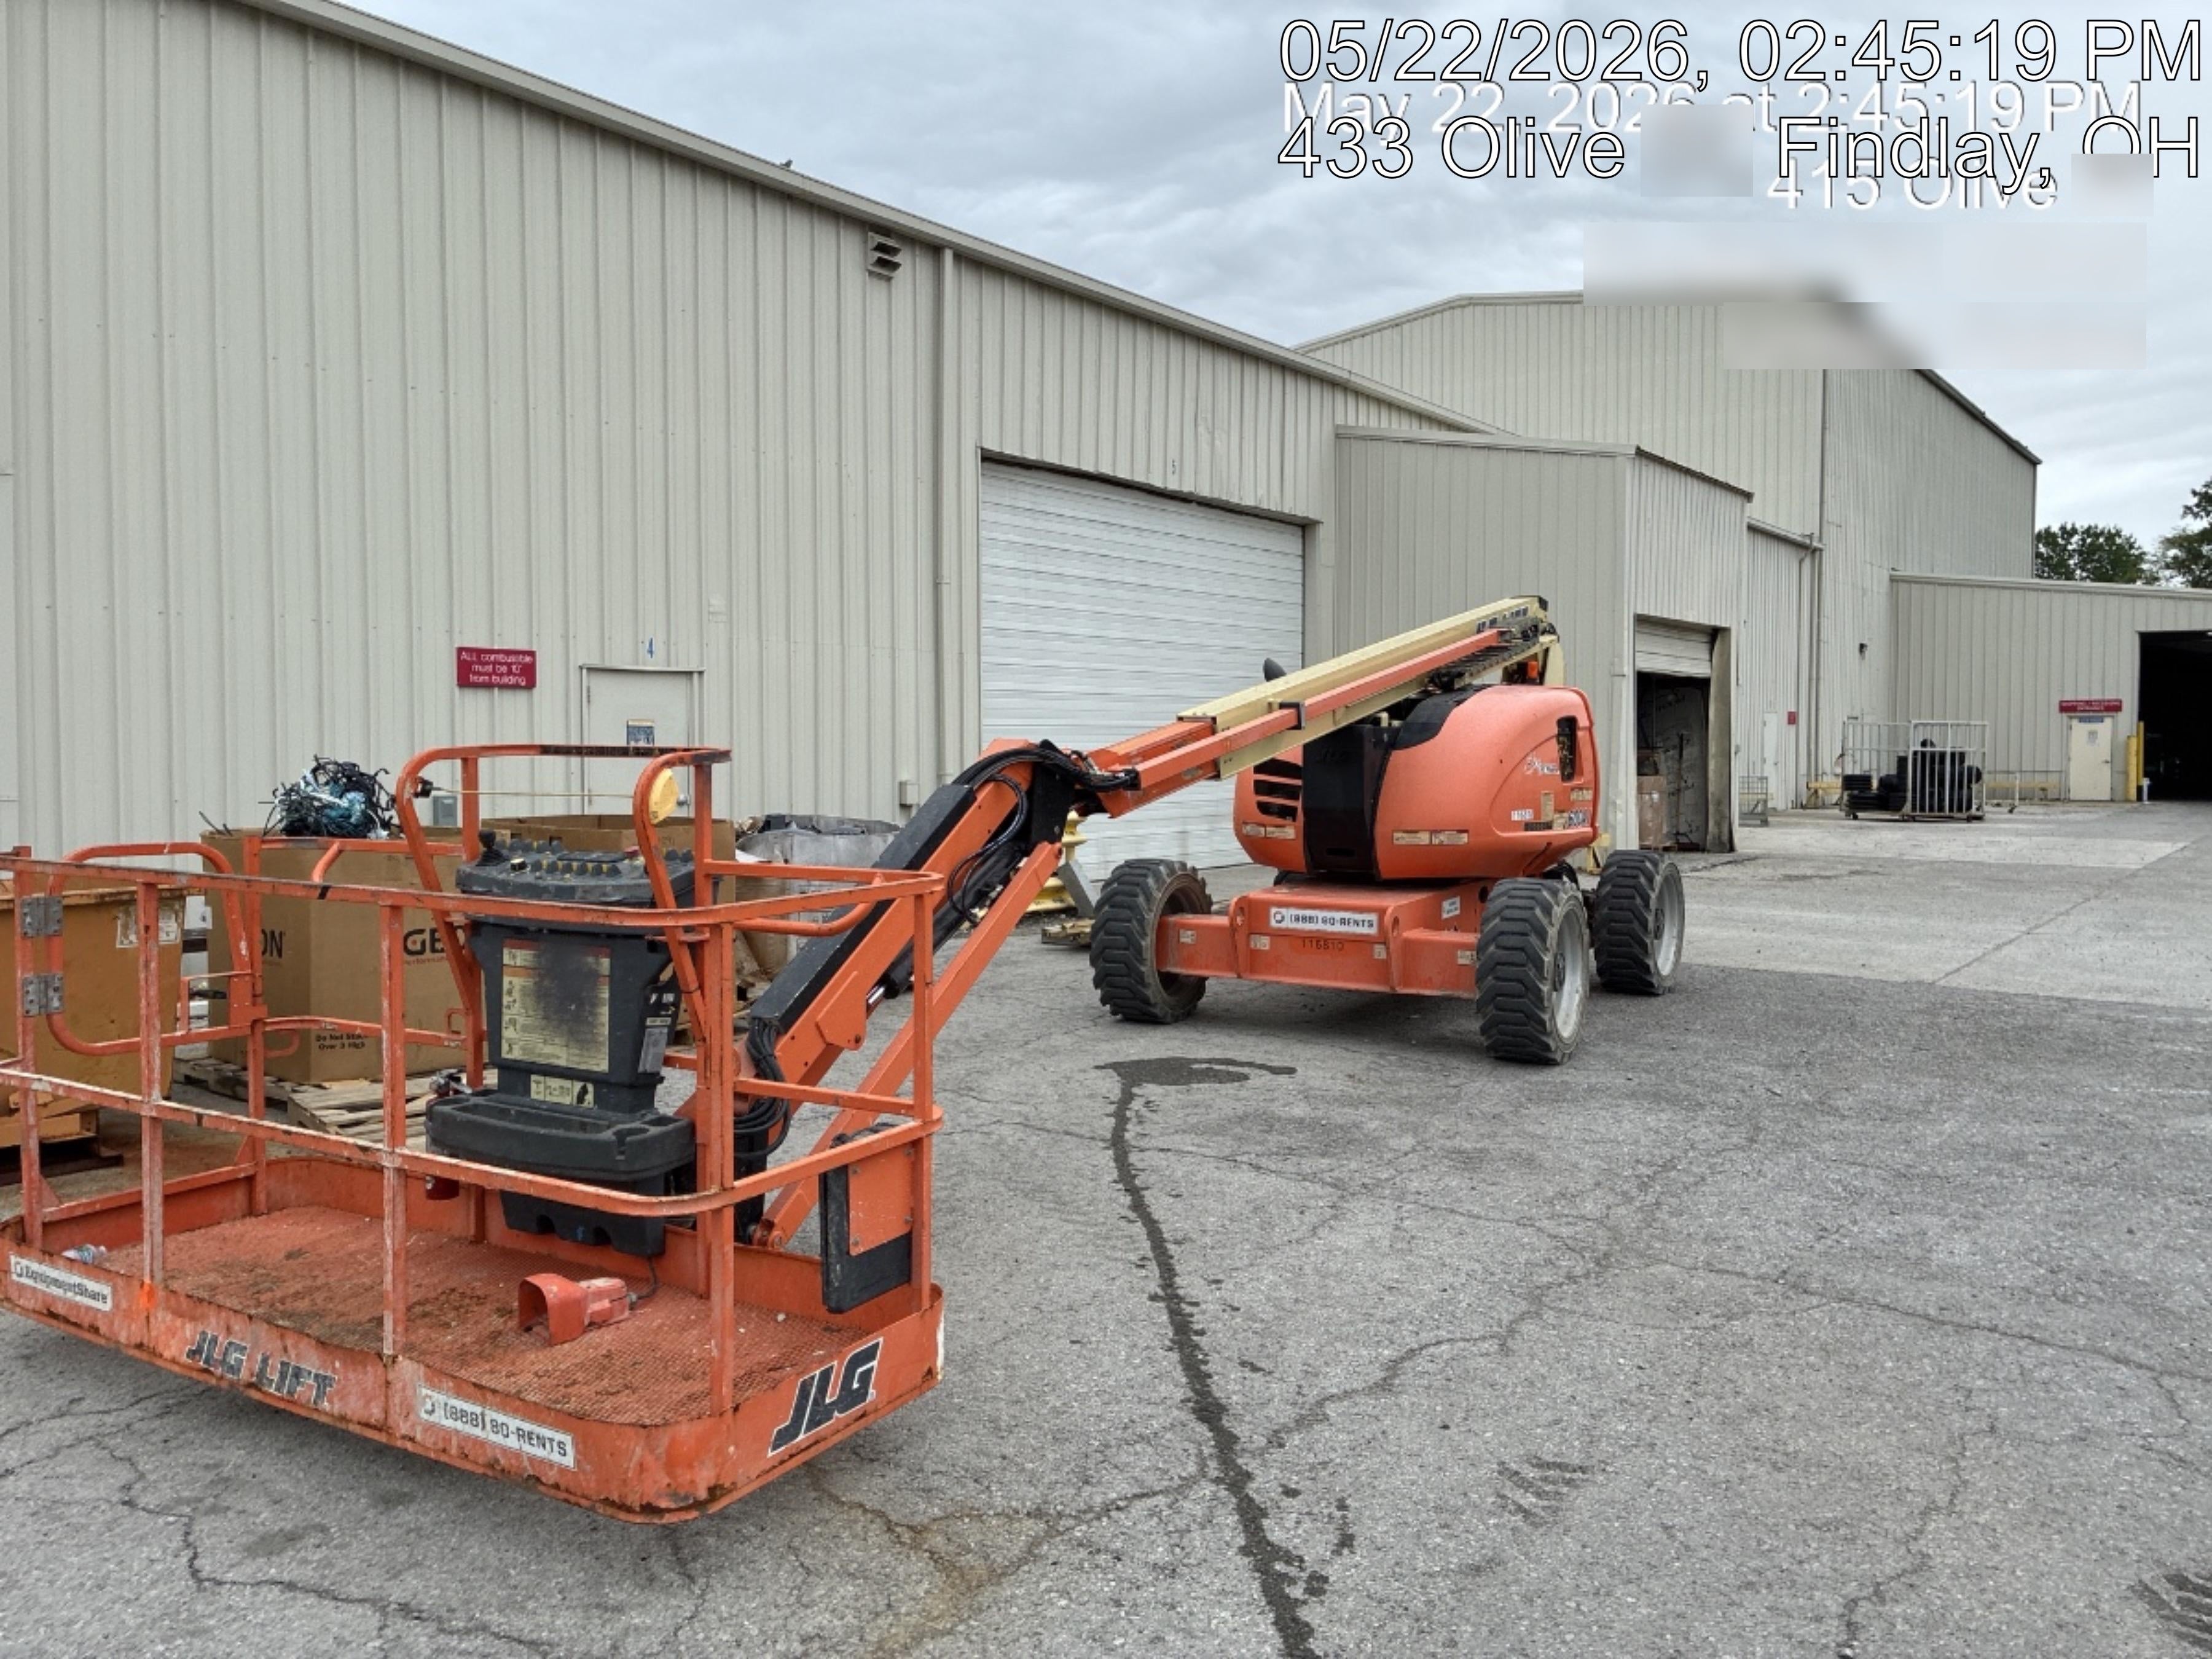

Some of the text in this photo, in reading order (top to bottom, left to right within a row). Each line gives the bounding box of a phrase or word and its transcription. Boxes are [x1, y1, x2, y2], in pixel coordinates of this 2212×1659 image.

[469, 673, 526, 686] from building
[471, 664, 492, 673] must
[495, 664, 508, 673] be
[186, 1329, 337, 1408] JLG LIFT
[767, 1336, 884, 1457] JLG
[490, 1418, 567, 1457] 80-RENTS
